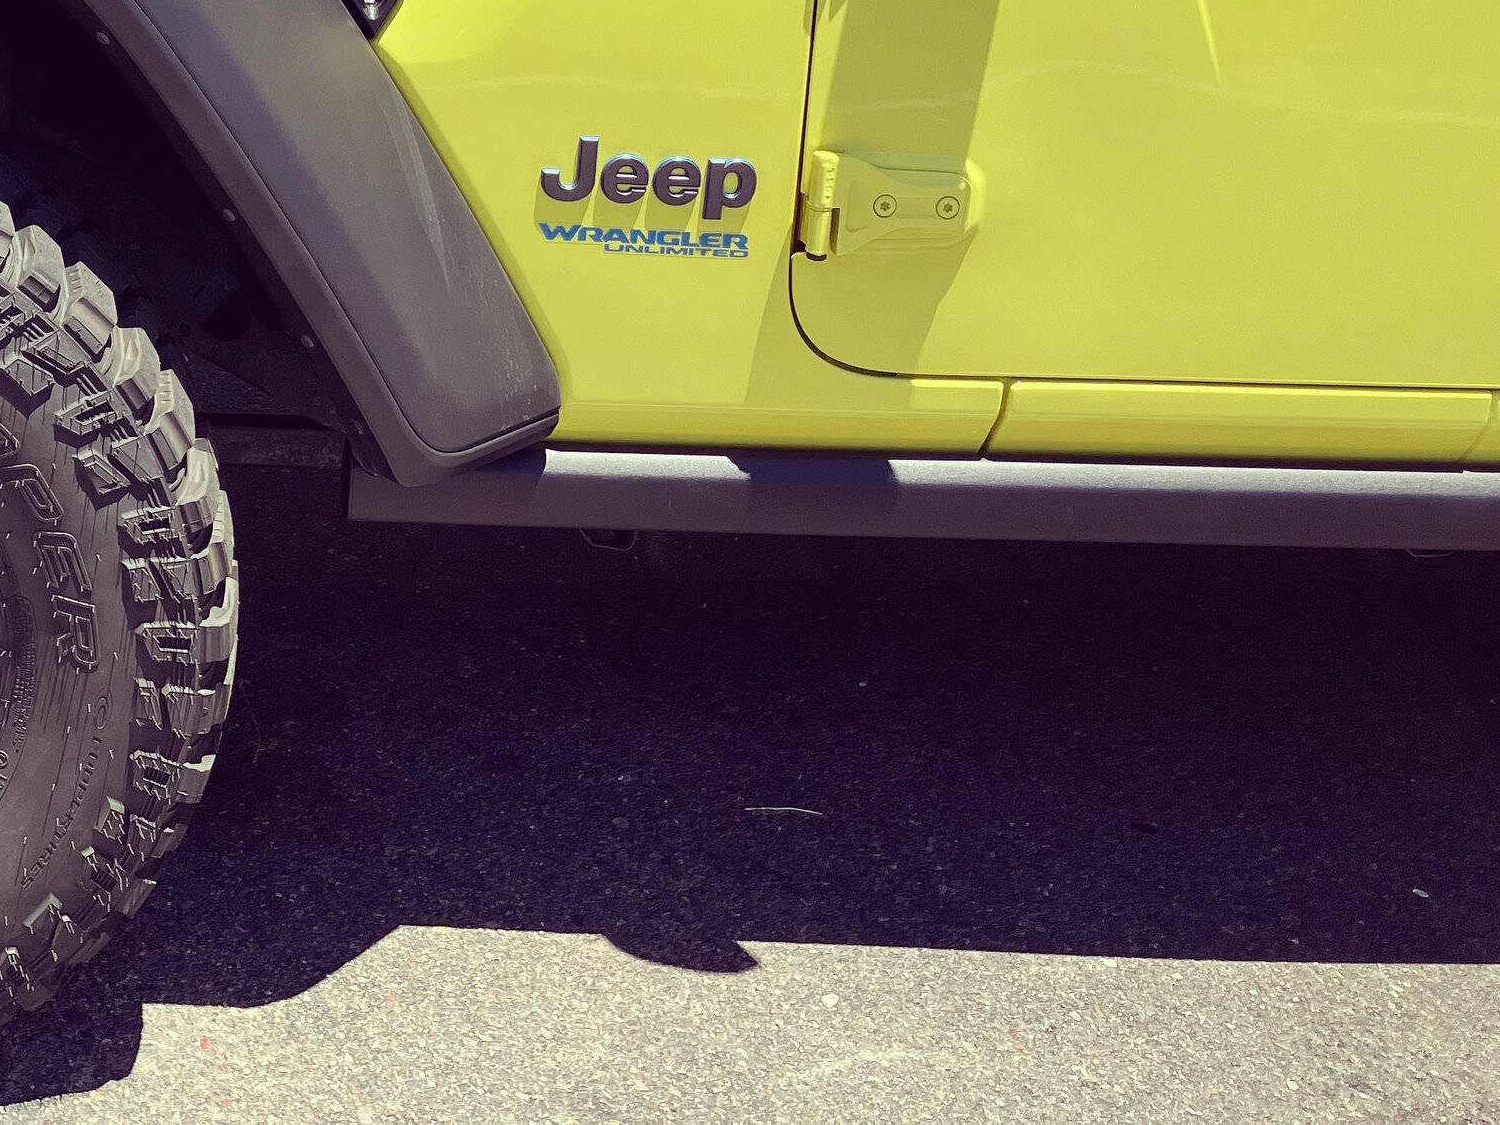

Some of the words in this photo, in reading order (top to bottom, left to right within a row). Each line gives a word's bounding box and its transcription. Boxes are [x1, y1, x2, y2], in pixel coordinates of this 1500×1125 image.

[540, 135, 758, 220] Jeep
[538, 222, 749, 249] WRANGLER
[604, 242, 749, 258] UNLIMITED
